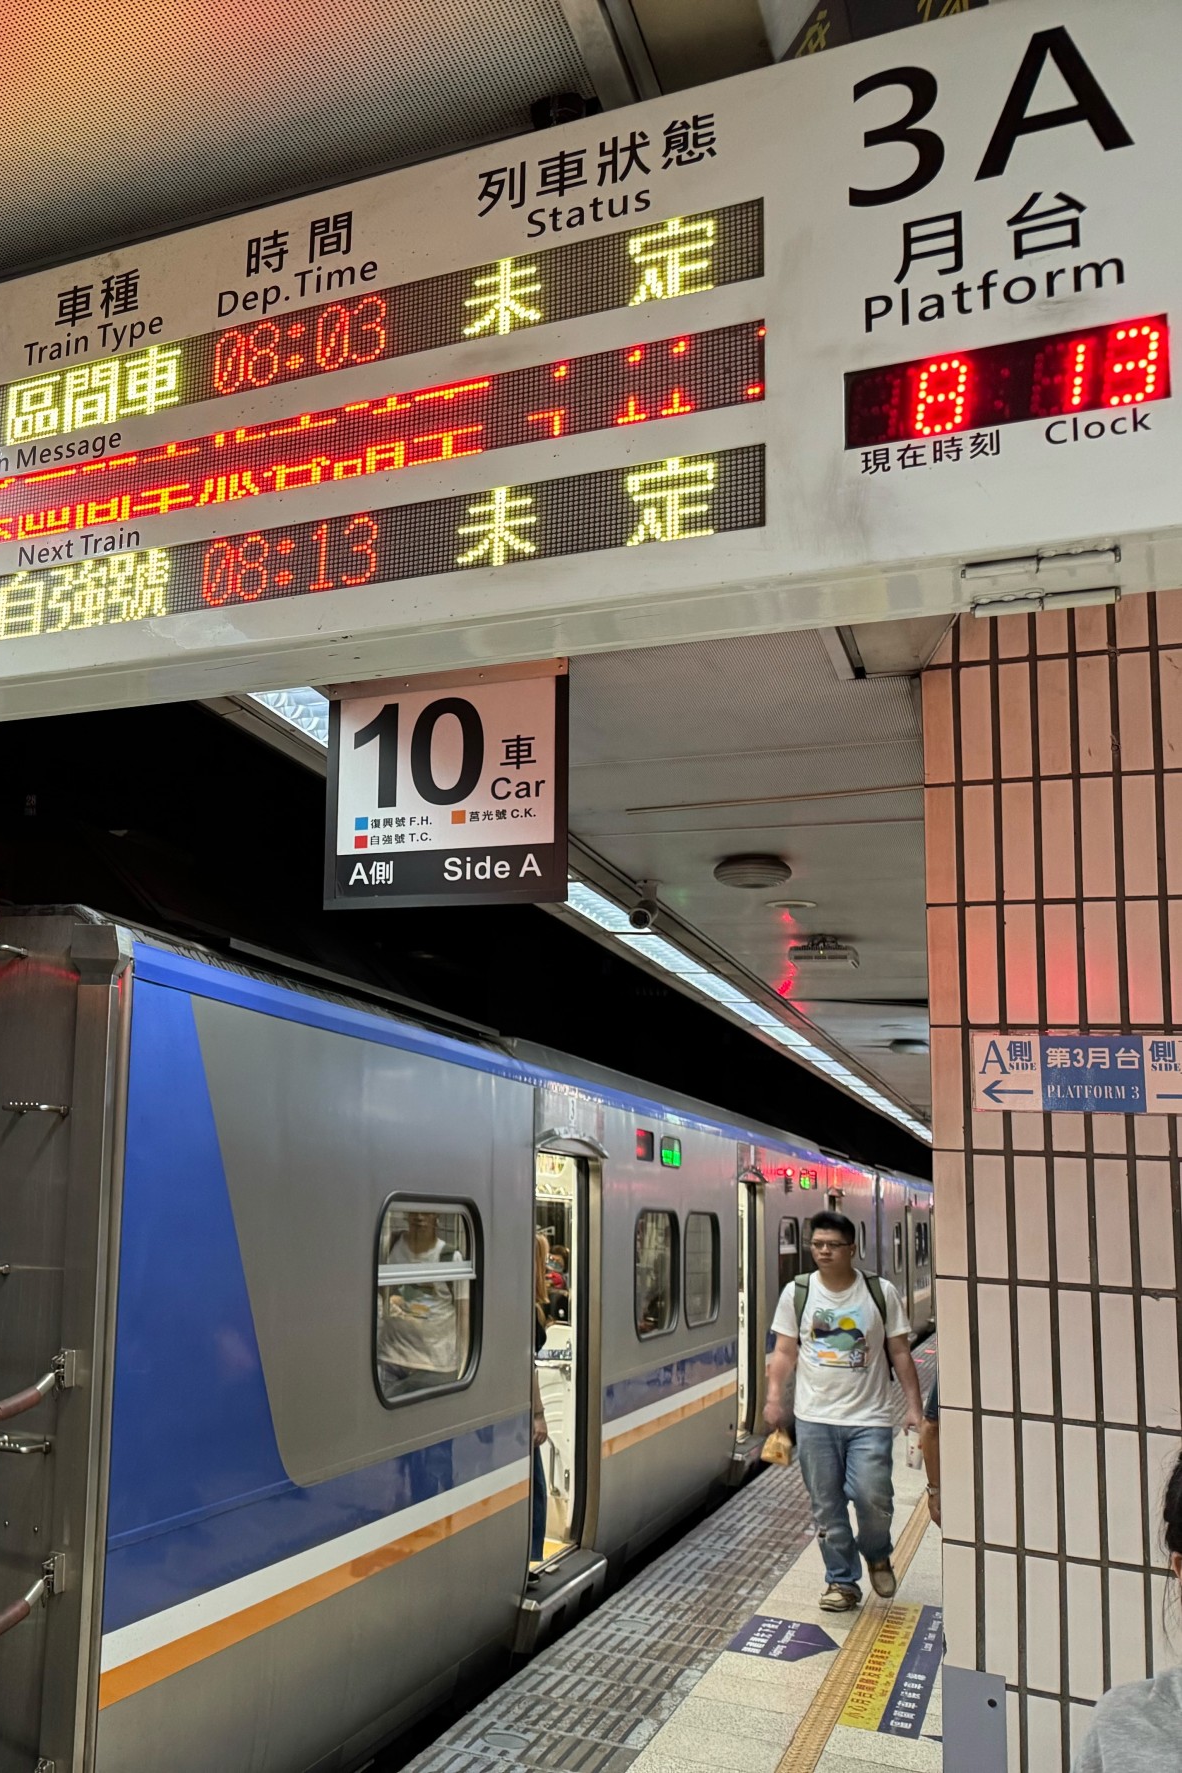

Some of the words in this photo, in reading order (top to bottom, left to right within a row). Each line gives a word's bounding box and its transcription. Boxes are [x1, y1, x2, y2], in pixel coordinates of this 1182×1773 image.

[849, 25, 1135, 207] 3A
[477, 113, 717, 218] 列車狀態
[527, 189, 652, 238] Status
[245, 211, 353, 278] 時間
[893, 191, 1087, 284] 月台
[55, 268, 140, 327] 車種
[864, 257, 1125, 333] Platform
[24, 333, 89, 366] Train
[97, 316, 163, 352] Type
[6, 347, 181, 445] 區間車
[213, 295, 387, 394] 08:03
[1045, 408, 1152, 445] Clock
[17, 431, 122, 468] Message
[861, 430, 1001, 475] 現在時刻
[18, 540, 74, 567] Next
[80, 527, 141, 557] Train
[201, 515, 378, 606] 08:13
[354, 697, 484, 808] 10
[500, 735, 536, 769] 車
[490, 777, 546, 800] Car
[370, 816, 406, 829] 復興號
[409, 816, 432, 827] F.H.
[469, 809, 507, 822] 莒光號
[511, 808, 536, 819] C.K.
[370, 833, 405, 846] 自強號
[409, 832, 432, 843] T.C.
[443, 856, 510, 881] Side
[519, 853, 542, 878] A
[1009, 1061, 1036, 1071] SIDE
[1046, 1047, 1141, 1070] 第3月台
[1047, 1084, 1126, 1100] PLATFORM
[1131, 1086, 1140, 1100] 3
